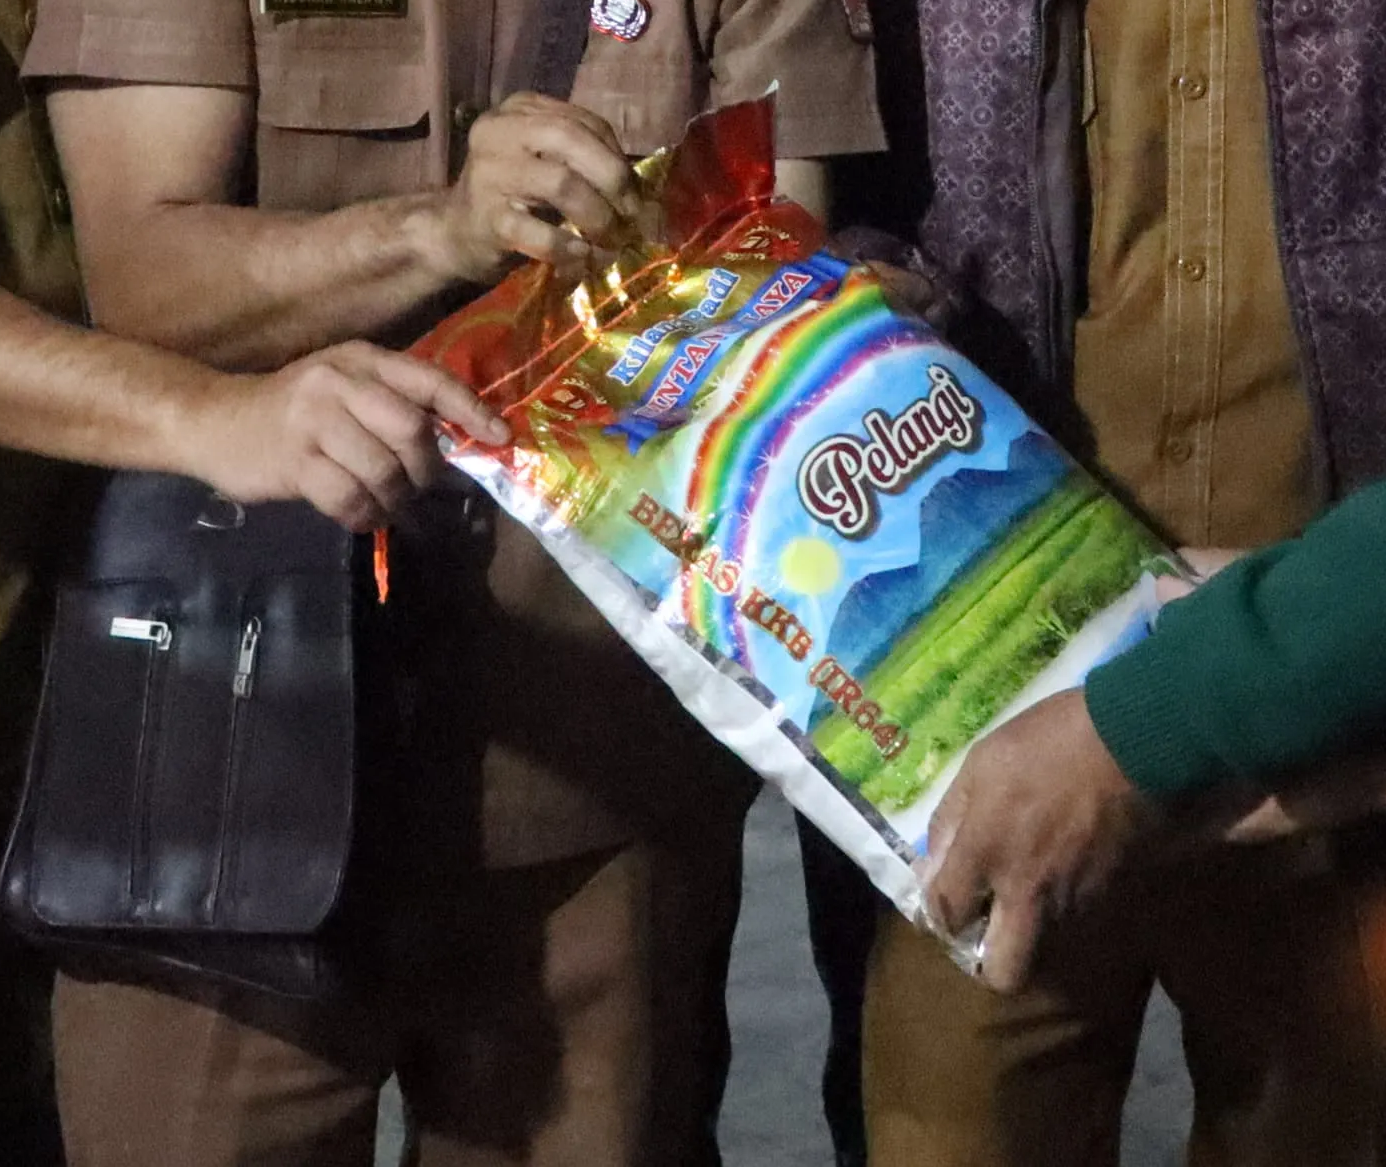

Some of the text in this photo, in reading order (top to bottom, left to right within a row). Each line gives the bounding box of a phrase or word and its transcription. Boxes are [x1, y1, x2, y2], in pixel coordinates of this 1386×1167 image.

[680, 267, 741, 325] Padi
[798, 363, 976, 534] Pelangi
[807, 654, 910, 761] (IR64)
